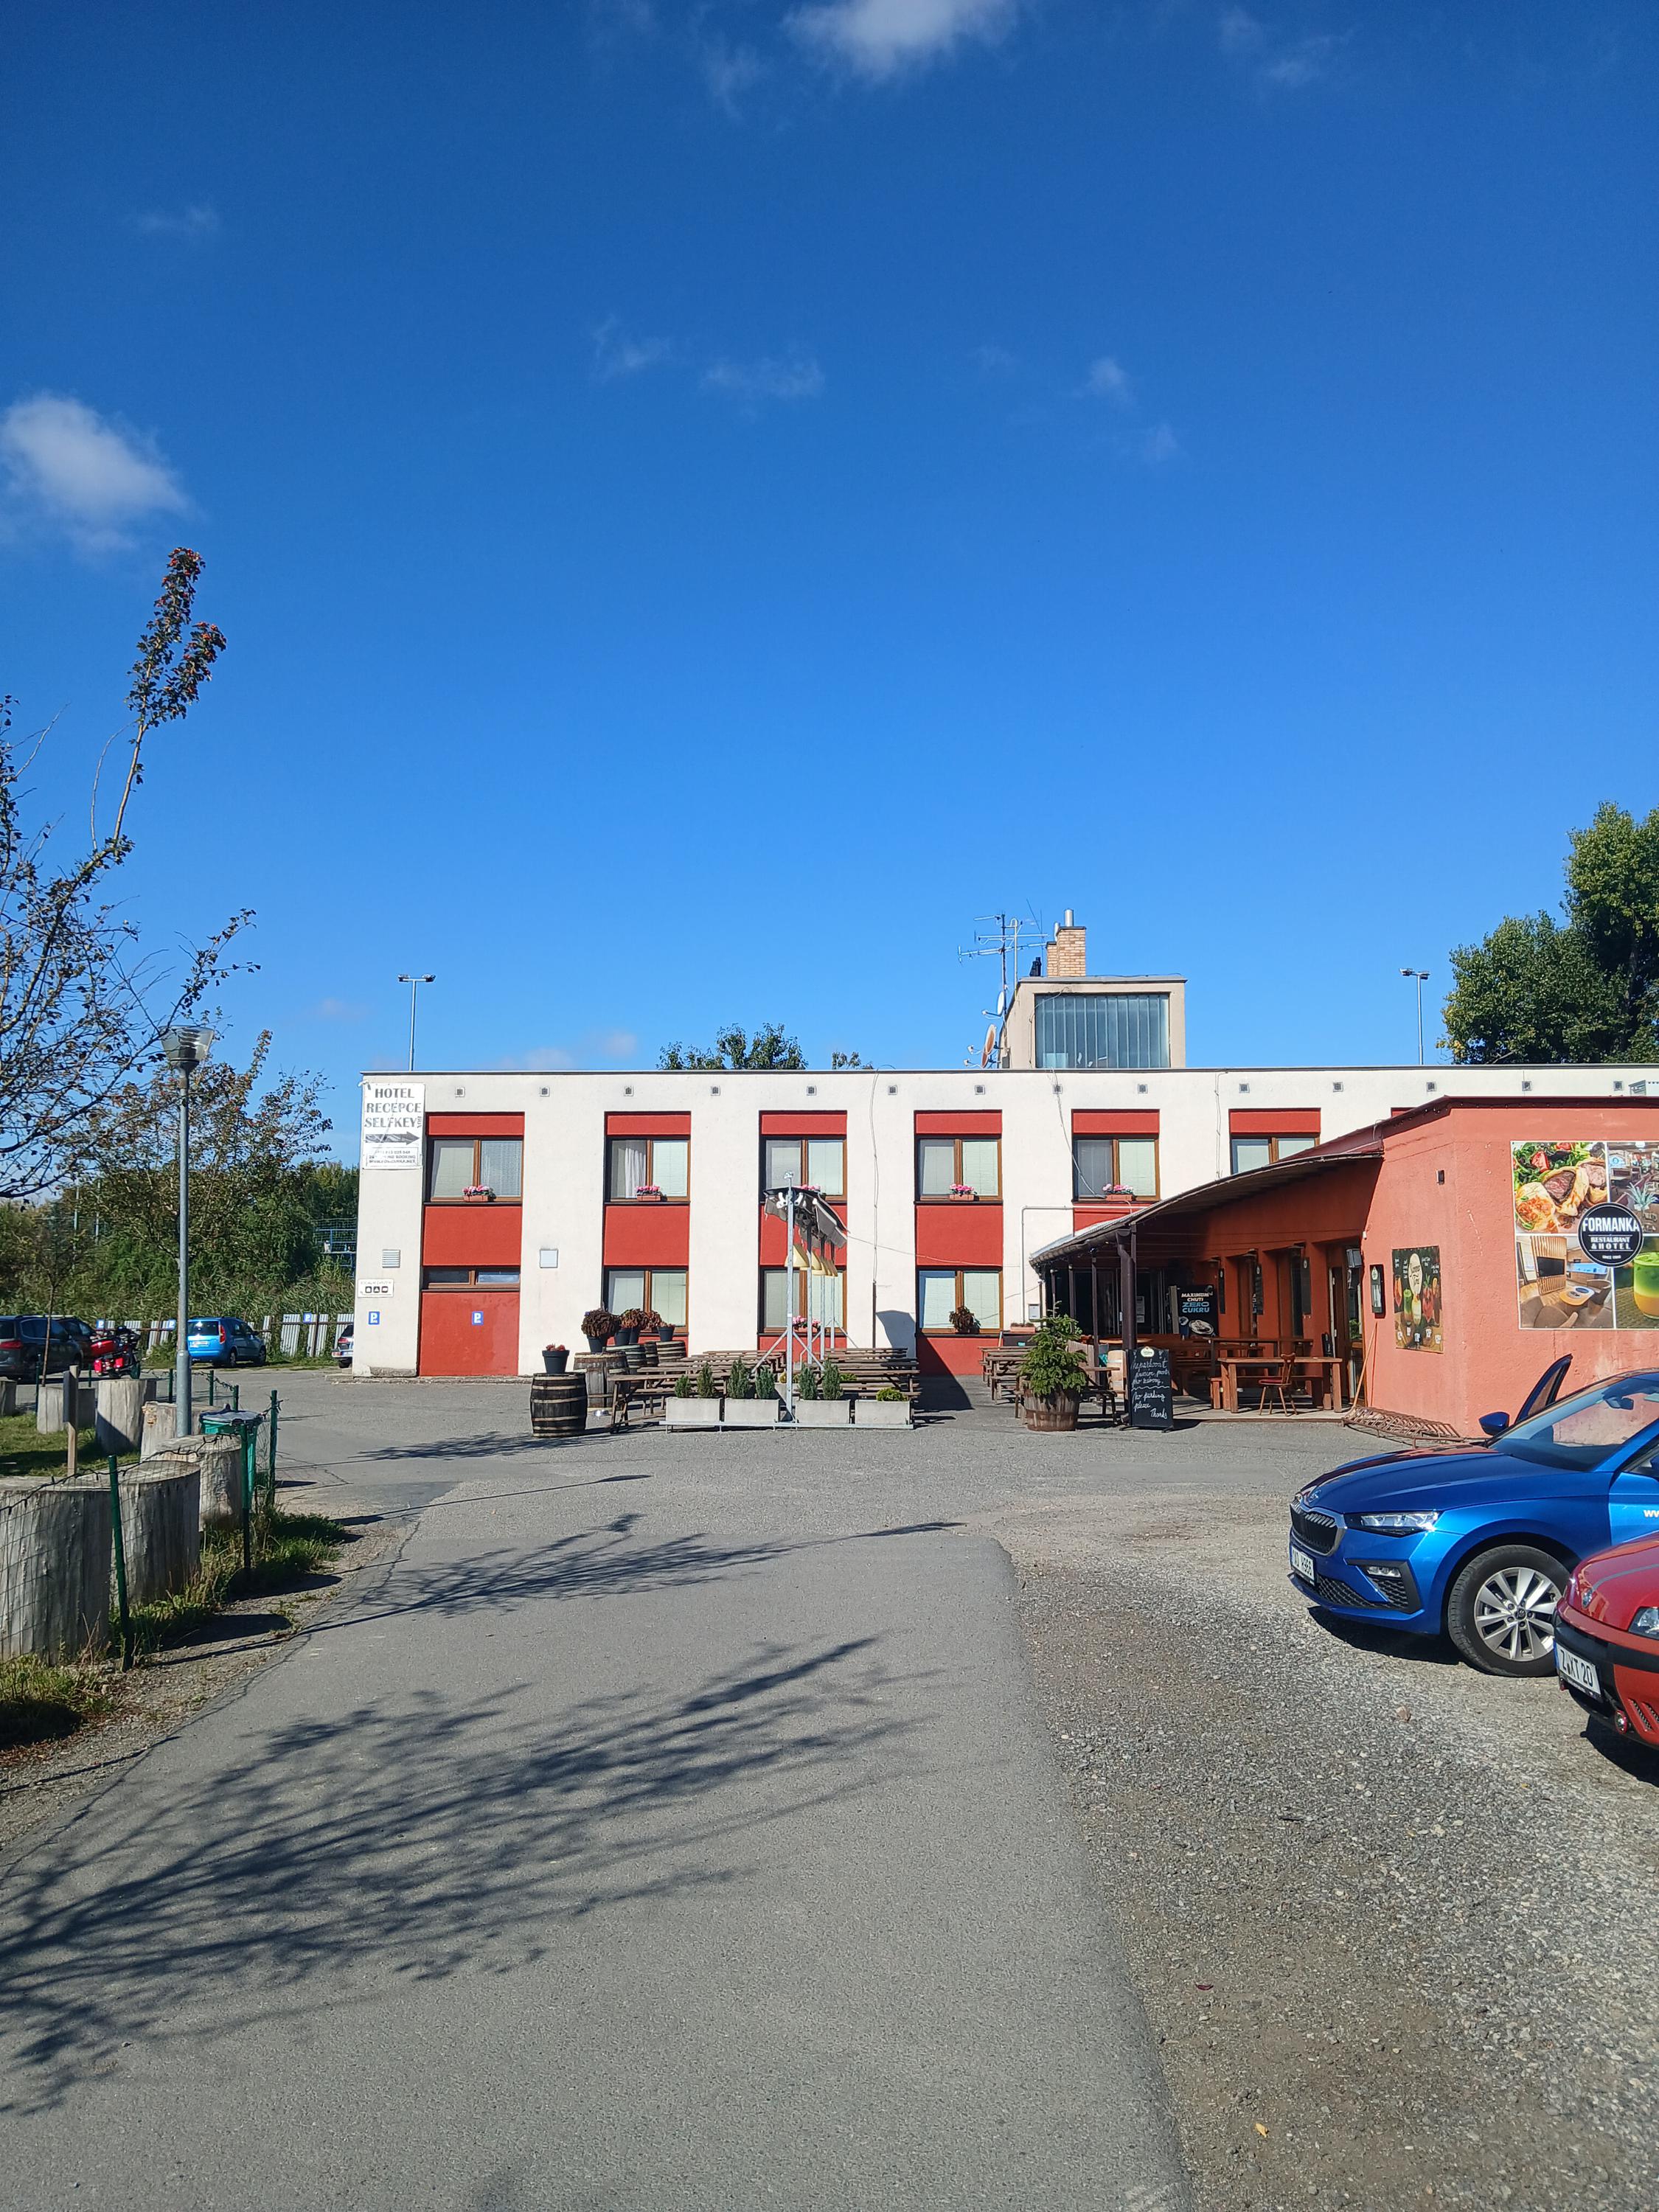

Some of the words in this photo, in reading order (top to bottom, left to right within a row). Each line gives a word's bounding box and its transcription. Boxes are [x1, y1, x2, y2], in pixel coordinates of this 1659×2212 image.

[375, 1088, 415, 1099] HOTEL
[366, 1102, 422, 1113] RECEPCE
[364, 1117, 417, 1128] SELFKEY
[1582, 1217, 1641, 1232] FORMANKA
[1559, 1649, 1567, 1672] Z
